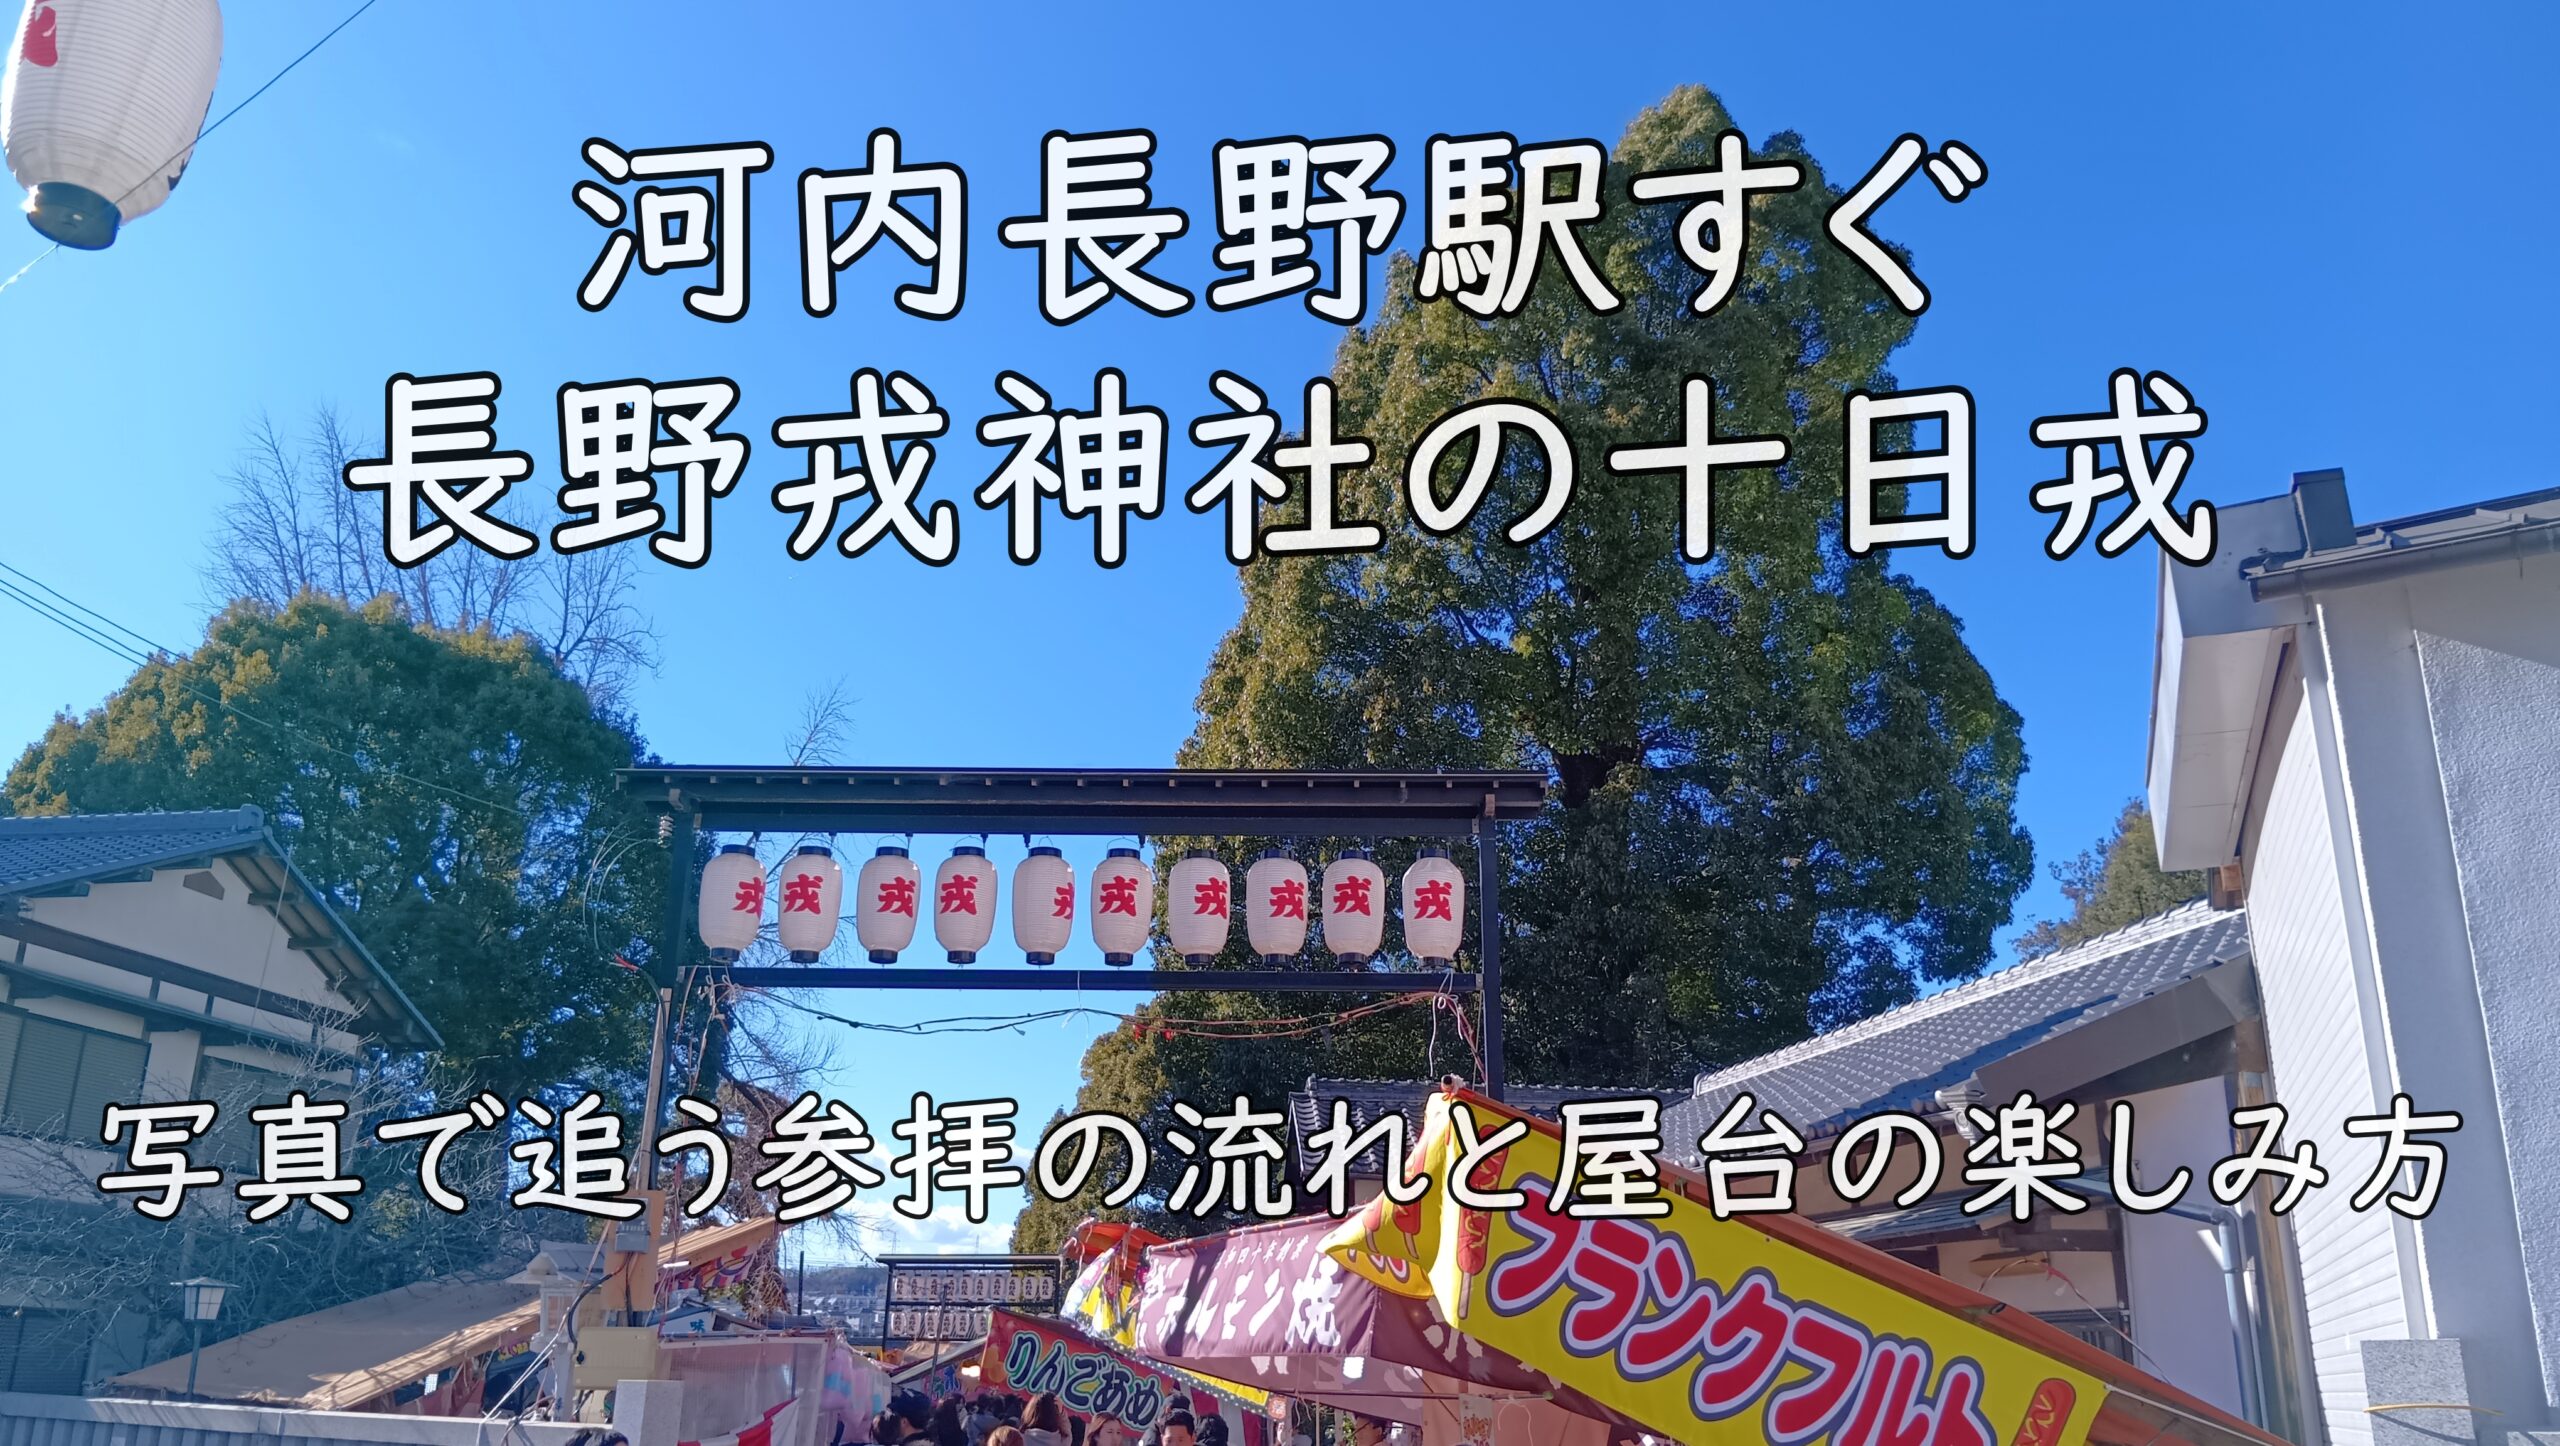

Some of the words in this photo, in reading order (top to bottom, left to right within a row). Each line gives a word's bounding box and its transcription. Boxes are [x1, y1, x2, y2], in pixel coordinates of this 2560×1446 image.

[784, 873, 823, 914] 戎
[878, 876, 915, 917] 戎
[940, 874, 978, 916] 戎
[1100, 875, 1139, 917] 戎
[1193, 877, 1228, 919] 戎
[1269, 879, 1305, 921] 戎
[1333, 875, 1372, 917] 戎
[1414, 879, 1452, 922] 戎
[1487, 1172, 1998, 1446] フランクフルト
[1004, 1330, 1166, 1431] りんごあめ
